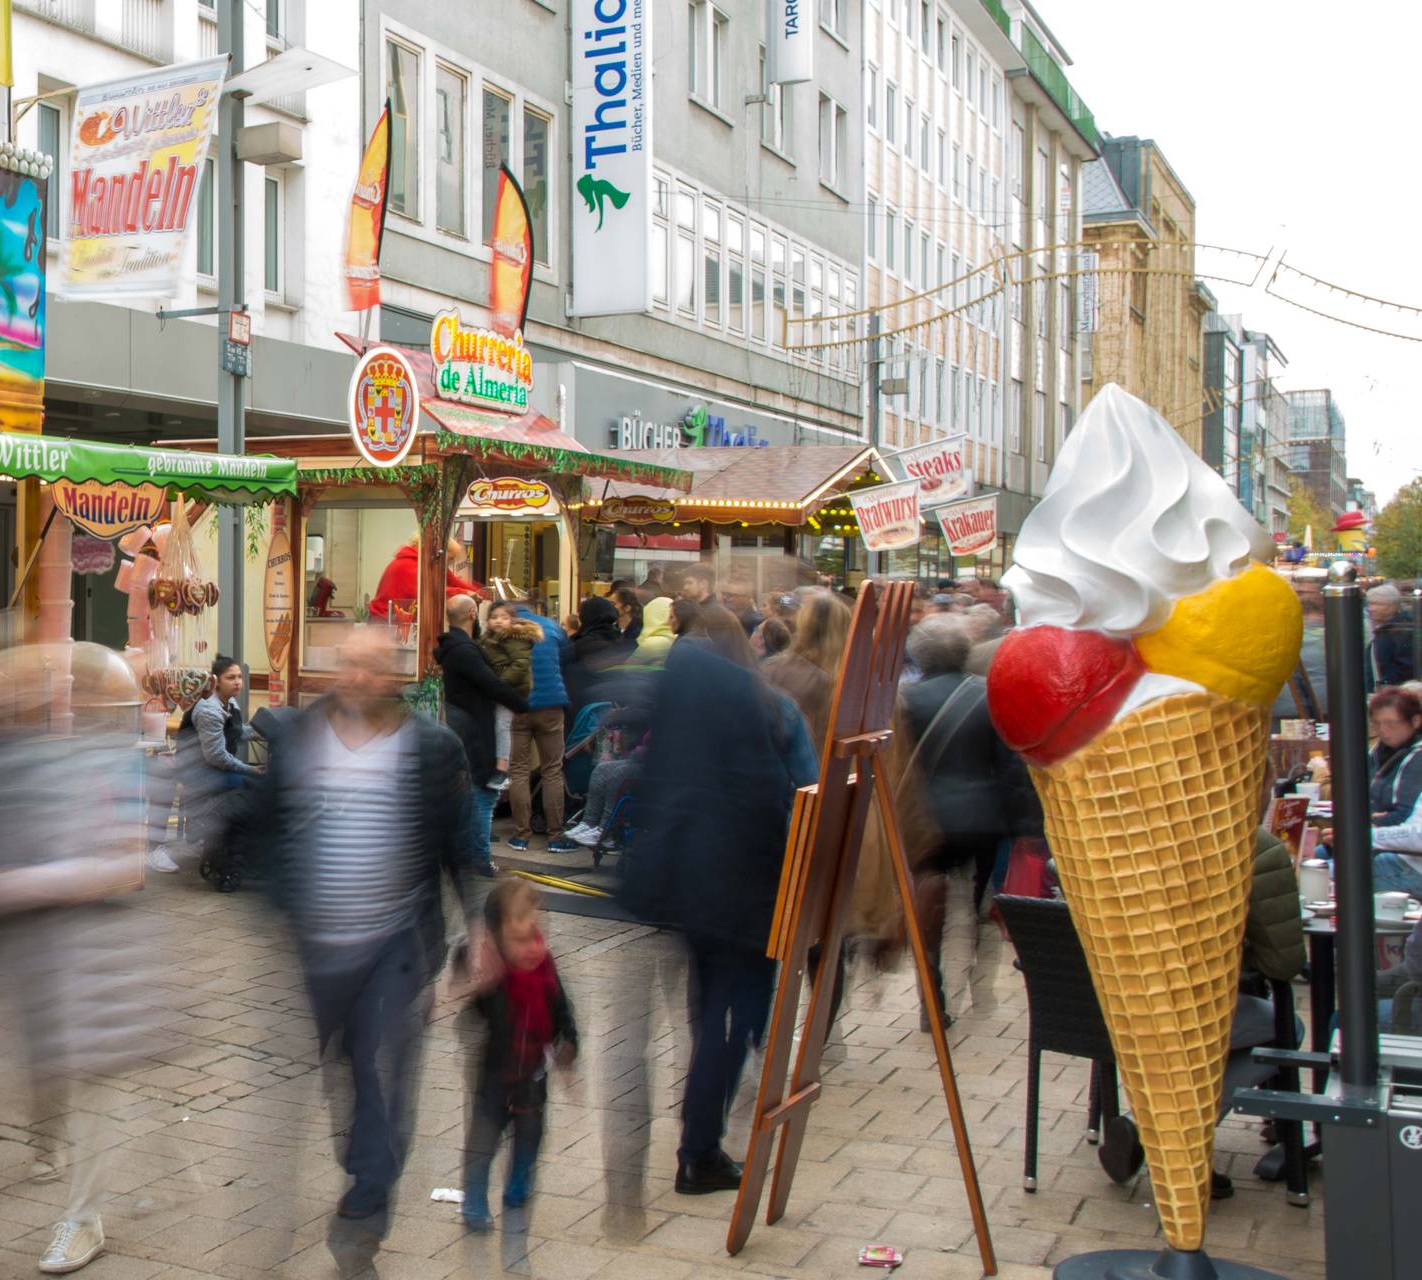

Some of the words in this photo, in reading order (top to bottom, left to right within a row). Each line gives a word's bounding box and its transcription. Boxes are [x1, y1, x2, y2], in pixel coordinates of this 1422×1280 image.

[630, 22, 642, 51] und
[784, 0, 800, 40] TAR
[631, 56, 643, 100] Medien
[631, 103, 645, 152] Bücher,
[68, 154, 199, 239] Mandeln
[439, 358, 460, 393] de
[621, 410, 681, 449] BÜCHER
[147, 451, 212, 477] gebrannte
[216, 456, 268, 480] Mandeln
[906, 449, 962, 478] steaks
[62, 486, 151, 525] Mandeln
[471, 484, 546, 502] Churros
[606, 500, 672, 516] Churros
[856, 492, 917, 534] Bratwurst
[941, 508, 995, 544] Krakauer
